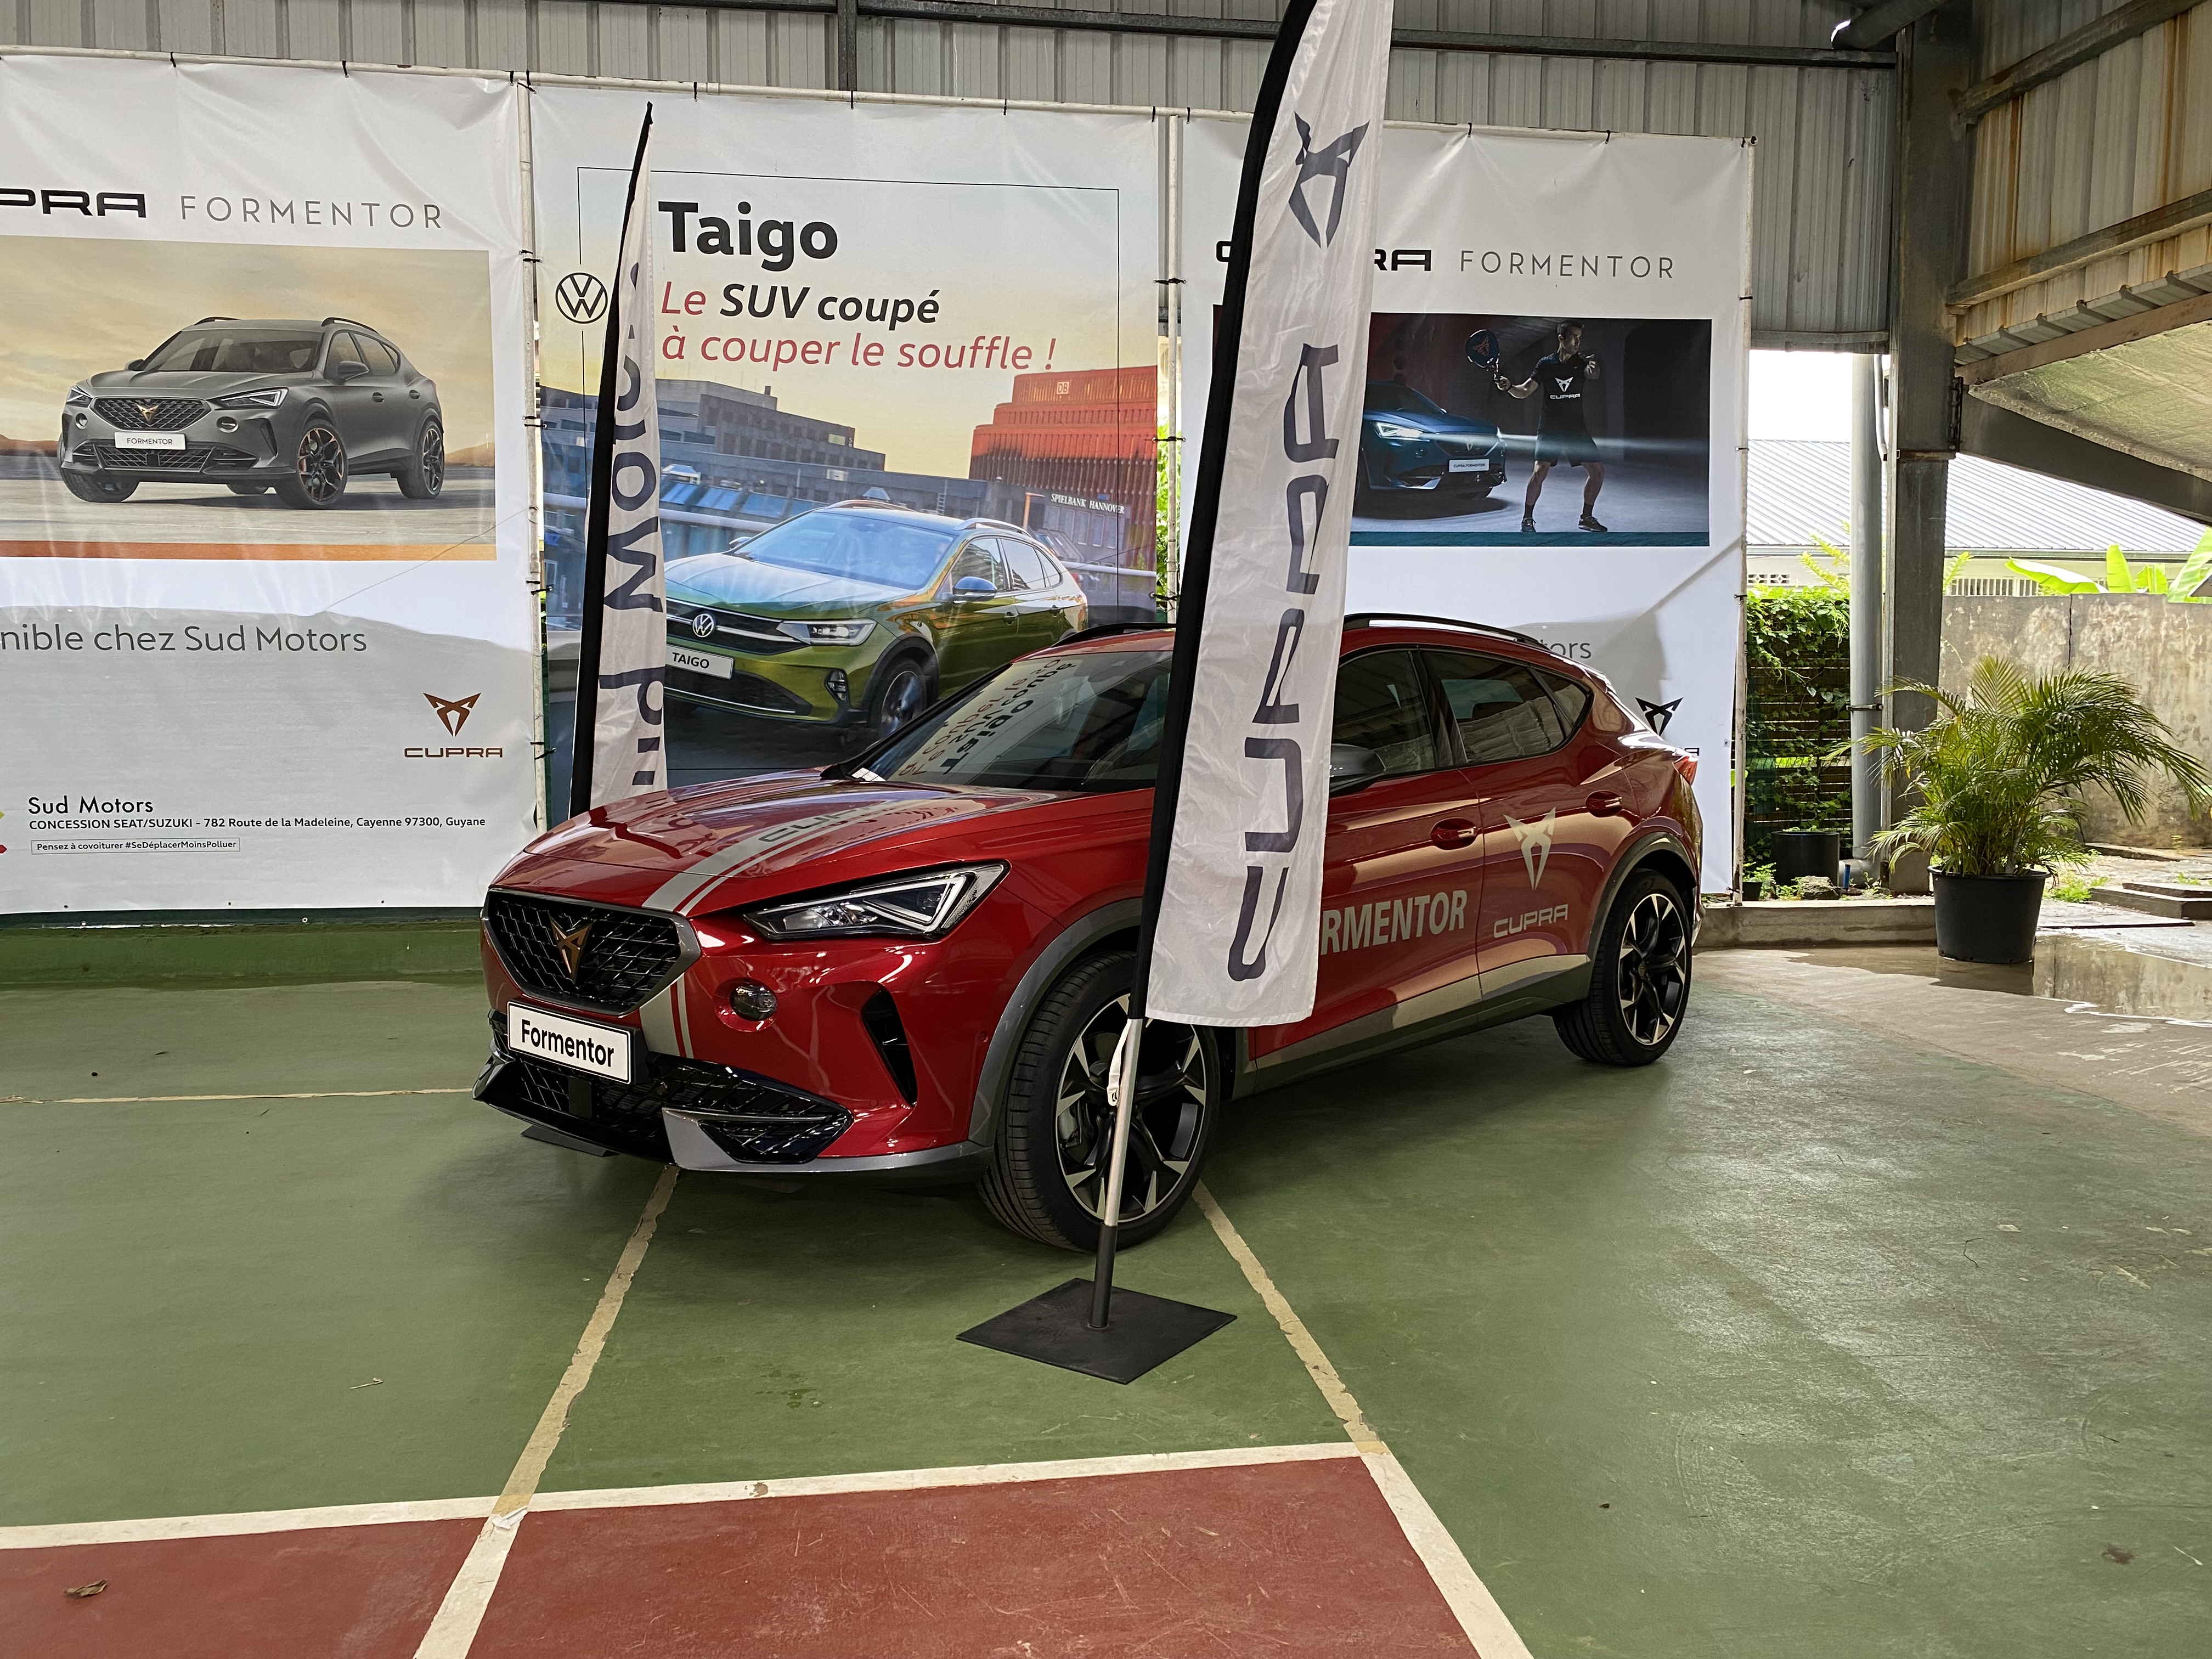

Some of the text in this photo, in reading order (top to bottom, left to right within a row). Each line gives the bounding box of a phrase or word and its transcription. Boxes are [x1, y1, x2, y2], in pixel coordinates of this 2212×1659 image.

[180, 195, 441, 229] FORMENTOR
[658, 201, 838, 272] Taigo
[1460, 250, 1673, 279] FORMENTOR
[661, 281, 940, 331] Le SUV coupé
[662, 325, 686, 360] à
[701, 336, 841, 372] couper
[851, 332, 884, 367] le
[897, 335, 1033, 370] souffle
[1058, 383, 1068, 393] DB
[1051, 493, 1125, 515] SPIELBANK HANNOVER
[1, 624, 367, 652] nible chez Sud Motors
[672, 652, 710, 669] TAIGO
[404, 748, 503, 758] CUPRA
[29, 795, 154, 815] Sud Motors
[30, 820, 110, 830] CONCESSION
[114, 818, 193, 829] SEAT/SUZUKI
[204, 818, 225, 828] 782
[229, 817, 262, 827] Route
[265, 817, 279, 827] de
[281, 817, 292, 827] la
[295, 817, 354, 828] Madeleine,
[356, 817, 403, 829] Cayenne
[405, 816, 443, 828] 97300,
[445, 817, 486, 829] Guyane
[70, 841, 76, 850] à
[78, 842, 123, 850] covoiturer
[125, 840, 237, 850] #SeDéplacerMoinsPolluer
[1321, 889, 1468, 956] RMENTOR
[1493, 904, 1568, 939] CUPRA
[522, 1018, 614, 1068] Formentor
